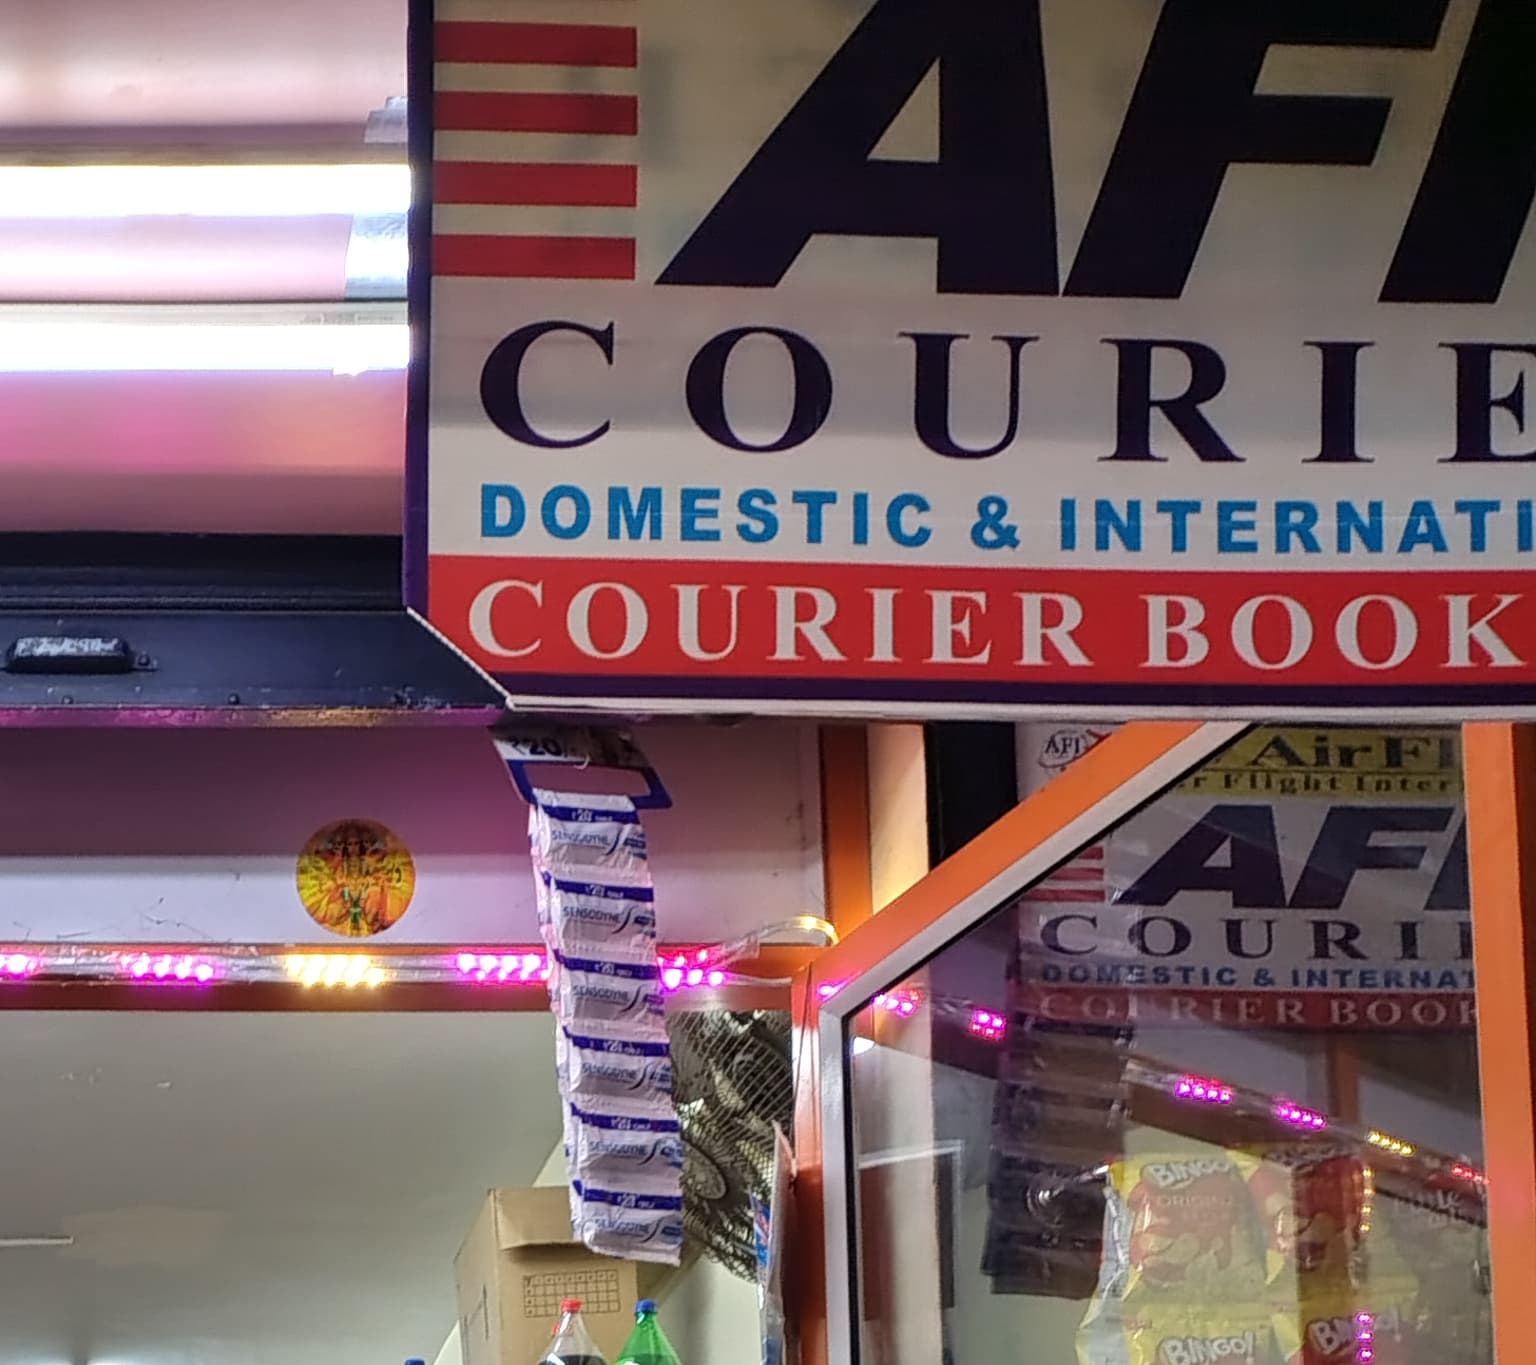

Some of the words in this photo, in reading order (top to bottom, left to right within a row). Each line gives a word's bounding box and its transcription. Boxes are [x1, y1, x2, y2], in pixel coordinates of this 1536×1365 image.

[479, 320, 1536, 463] COURIE
[481, 484, 932, 548] DOMESTIC
[972, 495, 1020, 549] &
[1063, 497, 1533, 554] INTERNATI
[468, 578, 1096, 668] COURIER
[1140, 594, 1527, 670] BOOK
[1041, 963, 1225, 985] DOMESTIC
[1253, 965, 1277, 986] &
